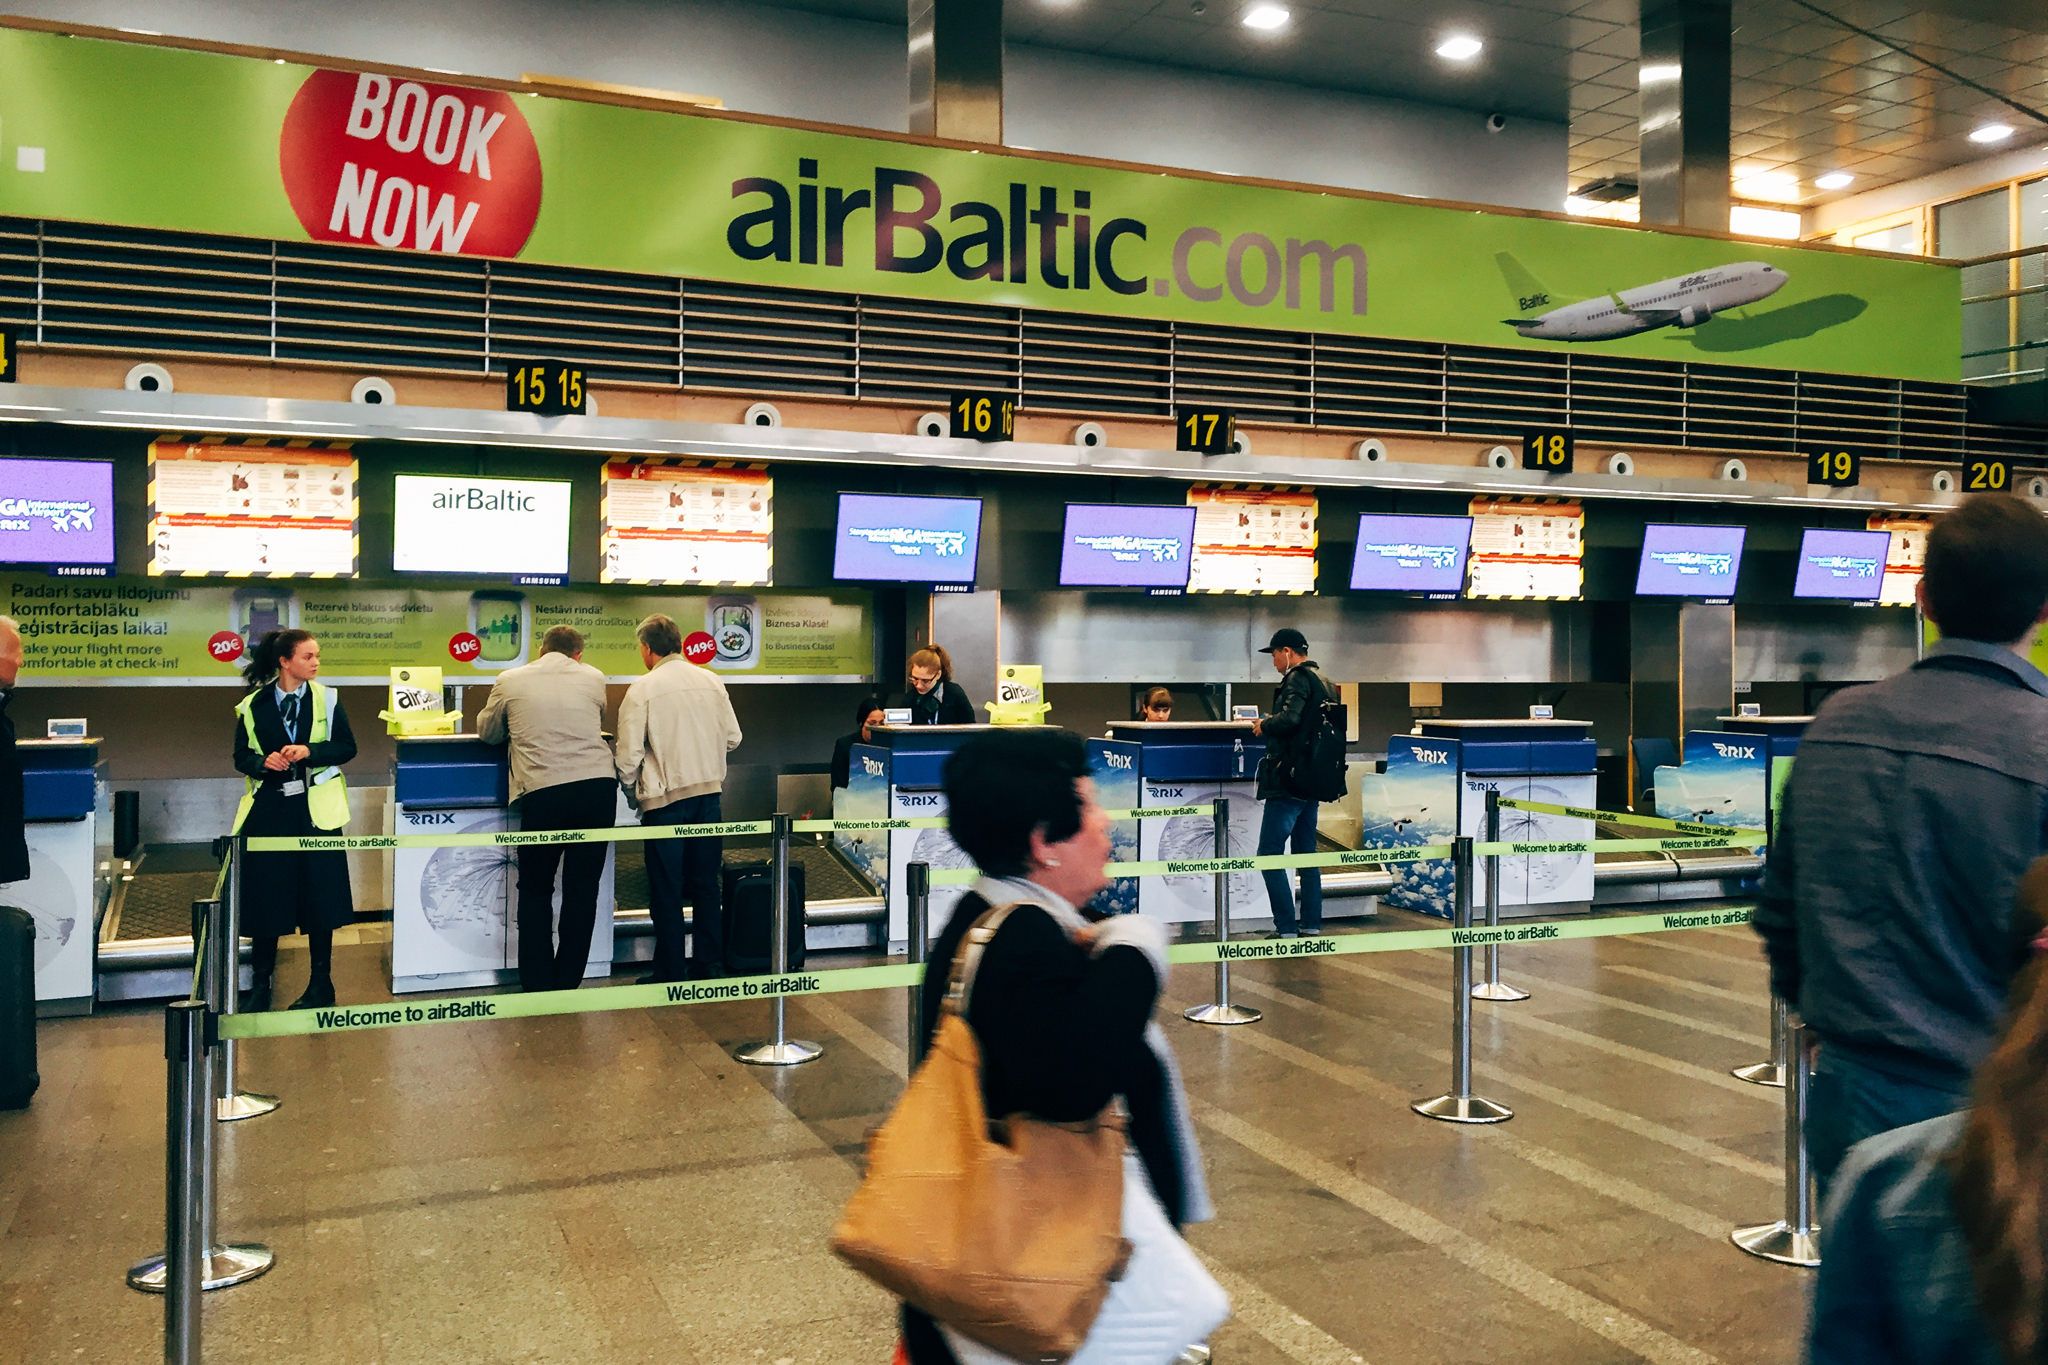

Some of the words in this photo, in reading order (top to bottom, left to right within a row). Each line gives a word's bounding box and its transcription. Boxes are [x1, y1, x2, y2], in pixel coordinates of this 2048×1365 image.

[345, 72, 506, 180] BOOK
[329, 162, 481, 254] NOW
[726, 158, 1369, 316] airBaltic.com
[1519, 294, 1549, 311] Baltic
[514, 367, 546, 405] 15
[558, 368, 582, 408] 15
[958, 398, 991, 432] 16
[1001, 400, 1013, 435] 16
[1186, 414, 1219, 446] 17
[1530, 435, 1566, 466] 18
[1817, 452, 1852, 481] 19
[1970, 462, 2006, 489] 20
[432, 487, 535, 513] airBaltic
[57, 567, 107, 576] SAMSUNG
[520, 576, 561, 585] SAMSUNG
[11, 583, 68, 598] Padari
[73, 586, 112, 599] savu
[117, 586, 191, 602] lidojumu
[11, 602, 139, 617] komfortablāku
[352, 602, 387, 612] blakus
[19, 617, 118, 637] eģistrācijas
[124, 621, 168, 636] laikā!
[765, 619, 801, 628] Biznesa
[25, 643, 48, 655] ake
[52, 645, 83, 657] your
[87, 643, 122, 657] flight
[126, 645, 162, 655] more
[212, 637, 241, 655] 20€
[453, 638, 478, 655] 10€
[686, 638, 716, 656] 149€
[22, 657, 96, 669] omfortable
[100, 658, 113, 669] at
[116, 657, 179, 669] check-in!
[1131, 809, 1162, 818] Welcome
[1163, 809, 1171, 817] to
[674, 827, 713, 836] Welcome
[715, 825, 724, 834] to
[725, 824, 758, 833] airBaltic
[833, 821, 870, 830] Welcome
[871, 820, 879, 829] to
[880, 819, 911, 828] airBaltic
[299, 838, 345, 848] Welcome
[359, 837, 398, 847] airBaltic
[495, 834, 537, 843] Welcome
[540, 833, 549, 842] to
[551, 832, 586, 841] airBaltic
[1660, 840, 1693, 849] Welcome
[1694, 840, 1701, 848] to
[1702, 838, 1729, 847] airBaltic
[1341, 853, 1379, 863] Welcome
[1380, 852, 1388, 861] to
[1390, 850, 1421, 860] airBaltic
[1513, 843, 1548, 853] Welcome
[1549, 844, 1557, 852] to
[1558, 843, 1587, 852] airBaltic
[1168, 862, 1209, 873] Welcome
[1210, 861, 1219, 871] to
[1220, 859, 1255, 870] airBaltic
[1663, 916, 1710, 928] Welcome
[1711, 913, 1720, 925] to
[1452, 930, 1502, 944] Welcome
[1504, 928, 1515, 941] to
[1517, 925, 1559, 939] airBaltic
[1217, 944, 1273, 959] Welcome
[1275, 942, 1288, 955] to
[1290, 940, 1336, 955] airBaltic
[666, 984, 740, 1001] Welcome
[742, 981, 758, 996] to
[761, 976, 820, 994] airBaltic
[316, 1008, 401, 1029] Welcome
[405, 1006, 423, 1022] to
[427, 1000, 497, 1020] airBaltic
